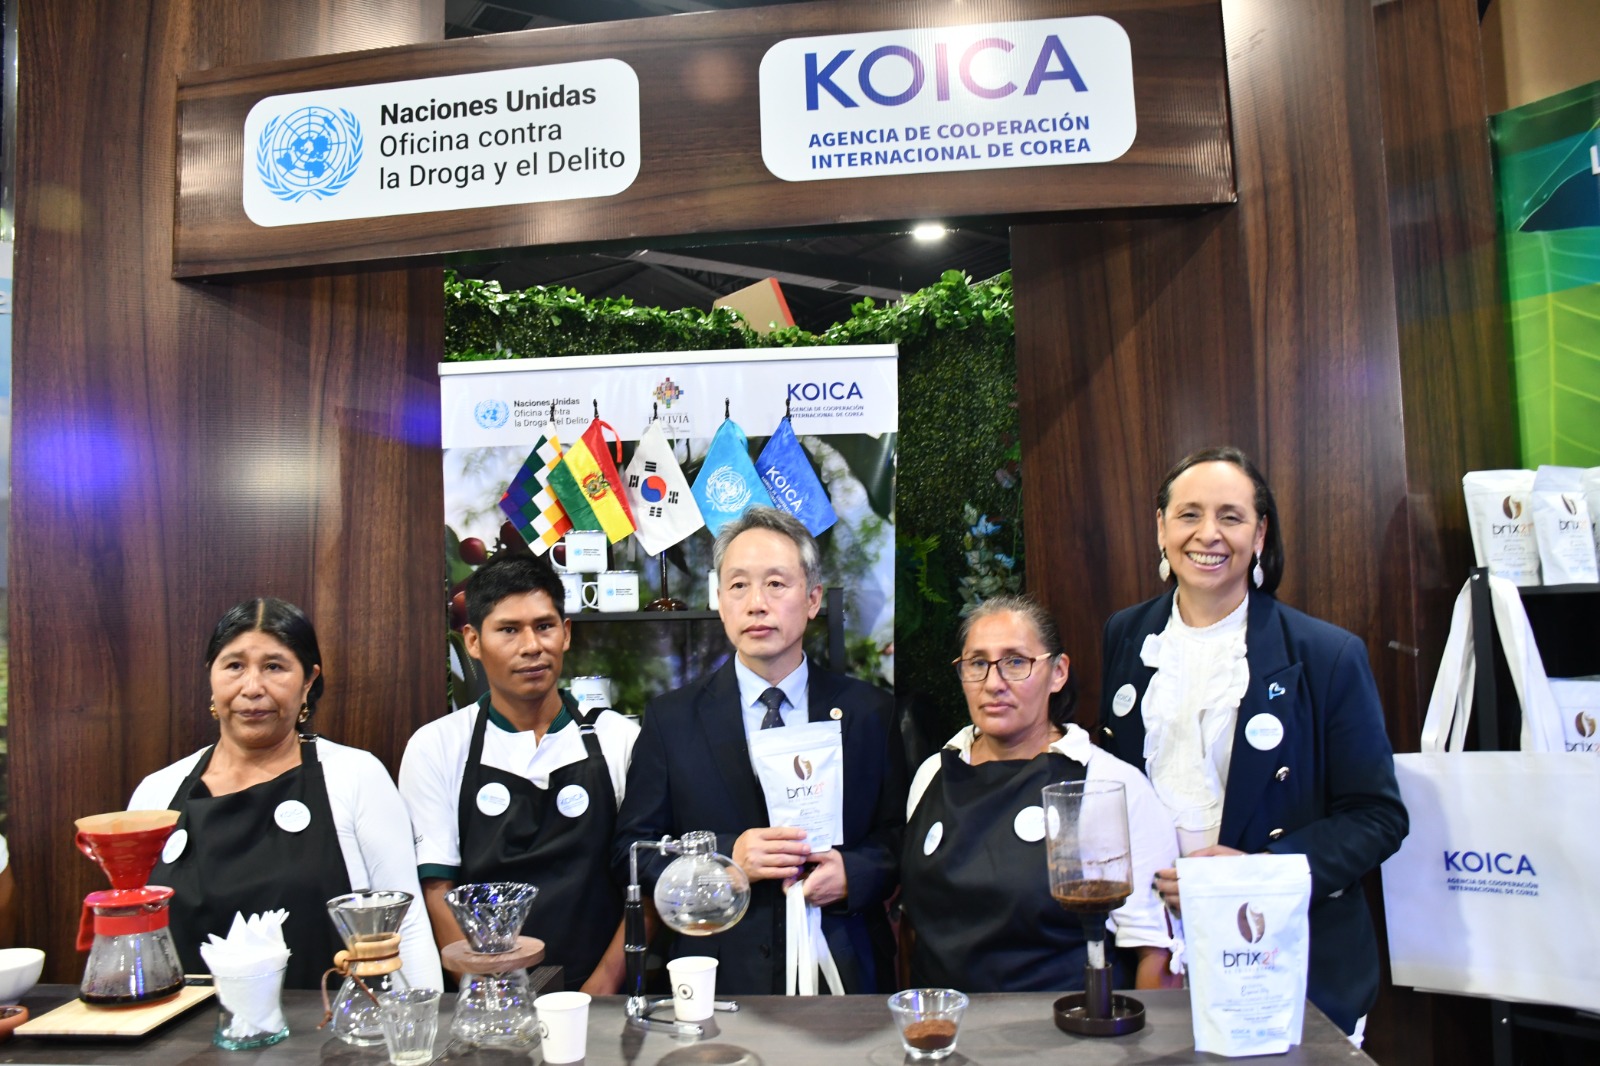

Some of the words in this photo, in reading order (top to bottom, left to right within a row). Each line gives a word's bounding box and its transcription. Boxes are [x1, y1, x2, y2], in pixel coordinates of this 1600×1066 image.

[805, 34, 1088, 111] KOICA
[380, 98, 498, 126] Naciones
[506, 84, 597, 113] Unidas
[379, 129, 469, 158] Oficina
[478, 121, 562, 148] contra
[808, 128, 899, 148] AGENCIA
[905, 125, 931, 142] DE
[937, 112, 1090, 140] COOPERACIÓN
[380, 167, 400, 190] la
[410, 162, 485, 188] Droga
[494, 161, 508, 185] y
[516, 152, 538, 176] el
[548, 146, 625, 174] Delito
[811, 146, 982, 169] INTERNACIONAL
[988, 141, 1014, 158] DE
[1020, 137, 1091, 156] COREA
[514, 399, 550, 408] Naciones
[552, 397, 580, 406] Unidas
[787, 382, 863, 401] KOICA
[514, 410, 542, 418] Oficina
[524, 419, 548, 428] Droga
[566, 416, 589, 426] Delito
[766, 466, 803, 513] KOICA
[1444, 850, 1536, 876] KOICA
